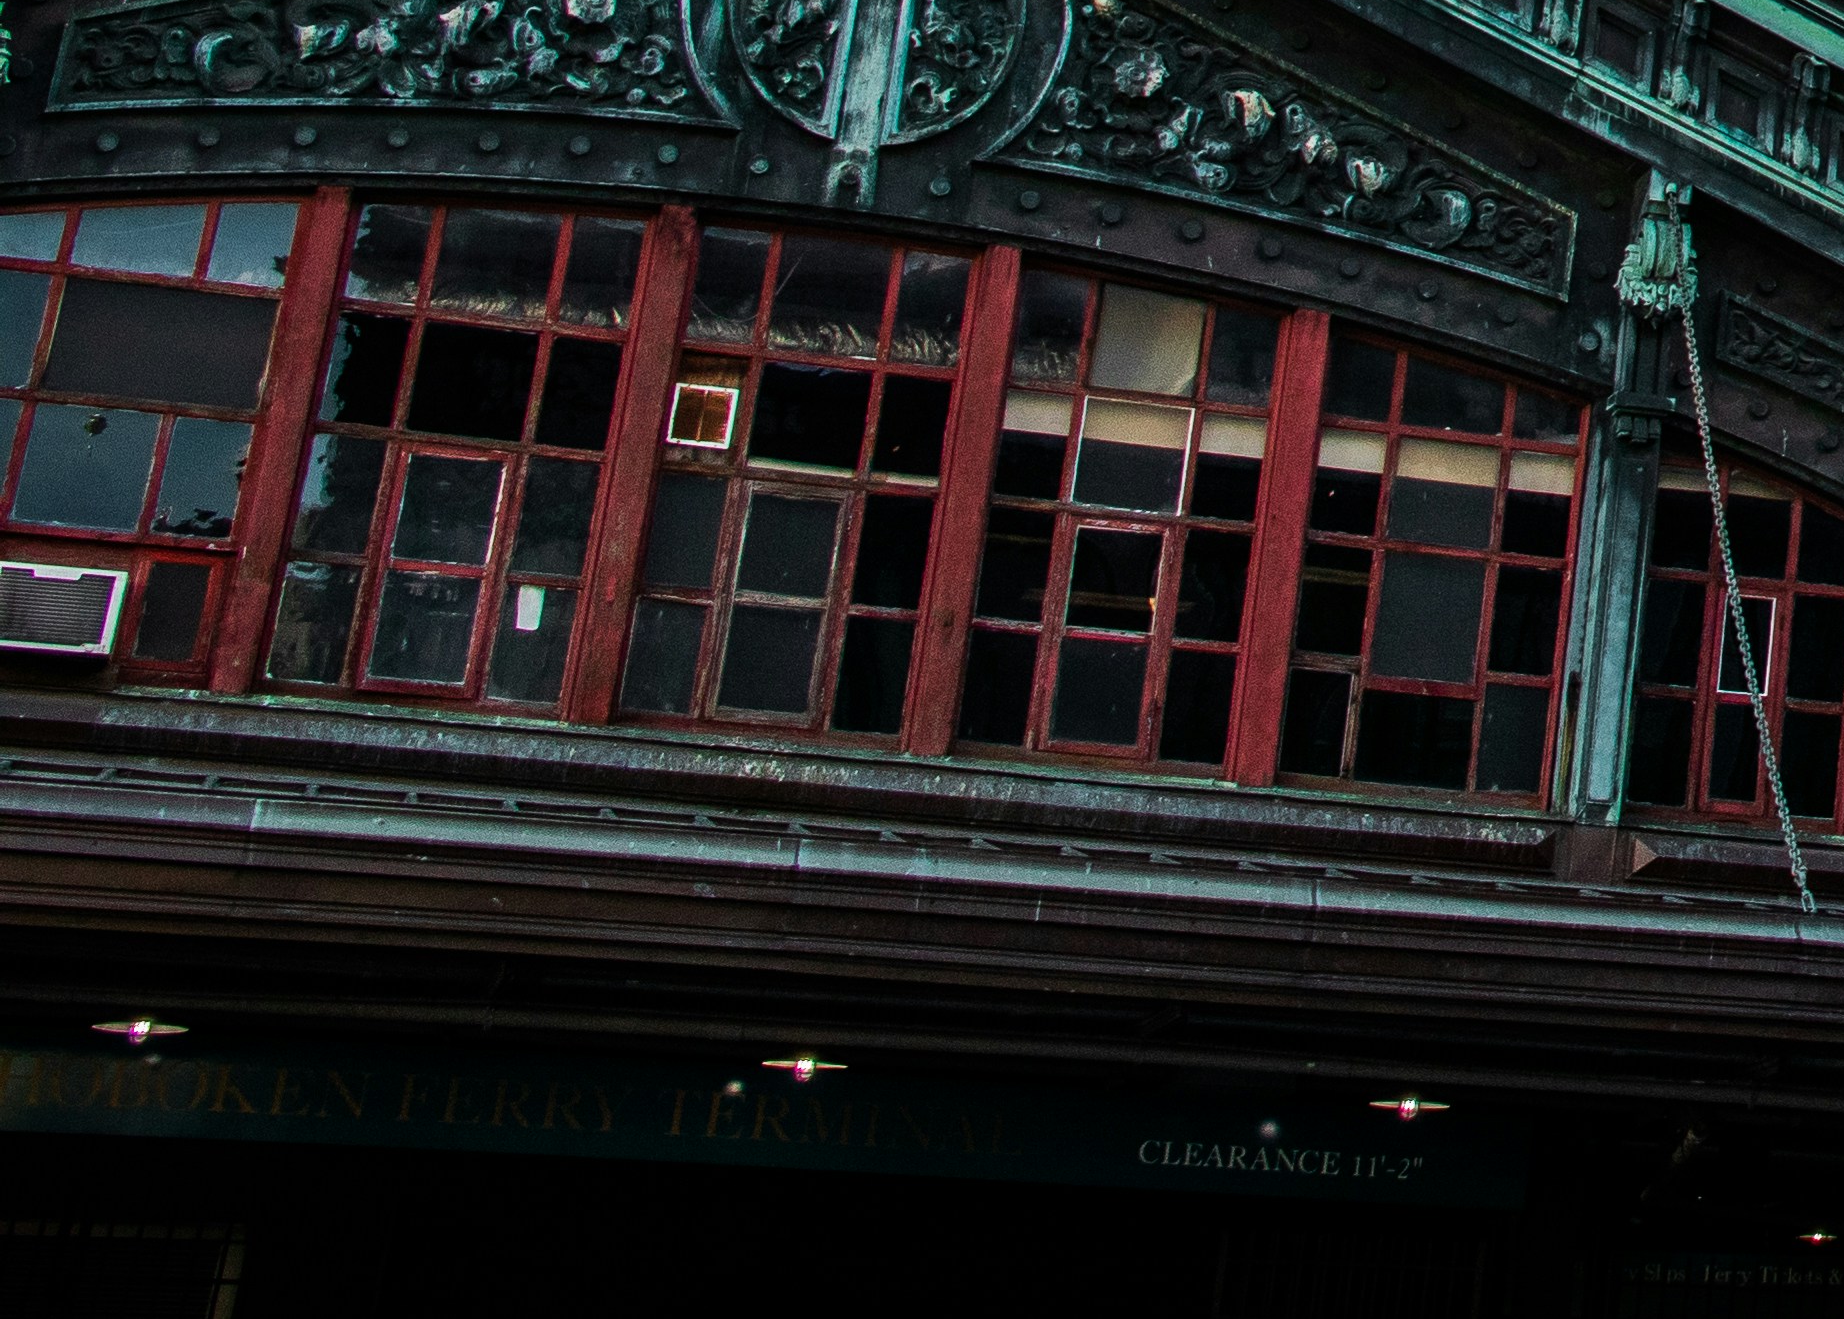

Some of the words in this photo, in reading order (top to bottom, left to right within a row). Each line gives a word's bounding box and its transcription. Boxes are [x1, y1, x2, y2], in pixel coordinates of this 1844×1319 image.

[396, 1072, 634, 1134] FERRY
[665, 1088, 1024, 1156] TERMINAL
[1138, 1139, 1342, 1176] CLEARANCE
